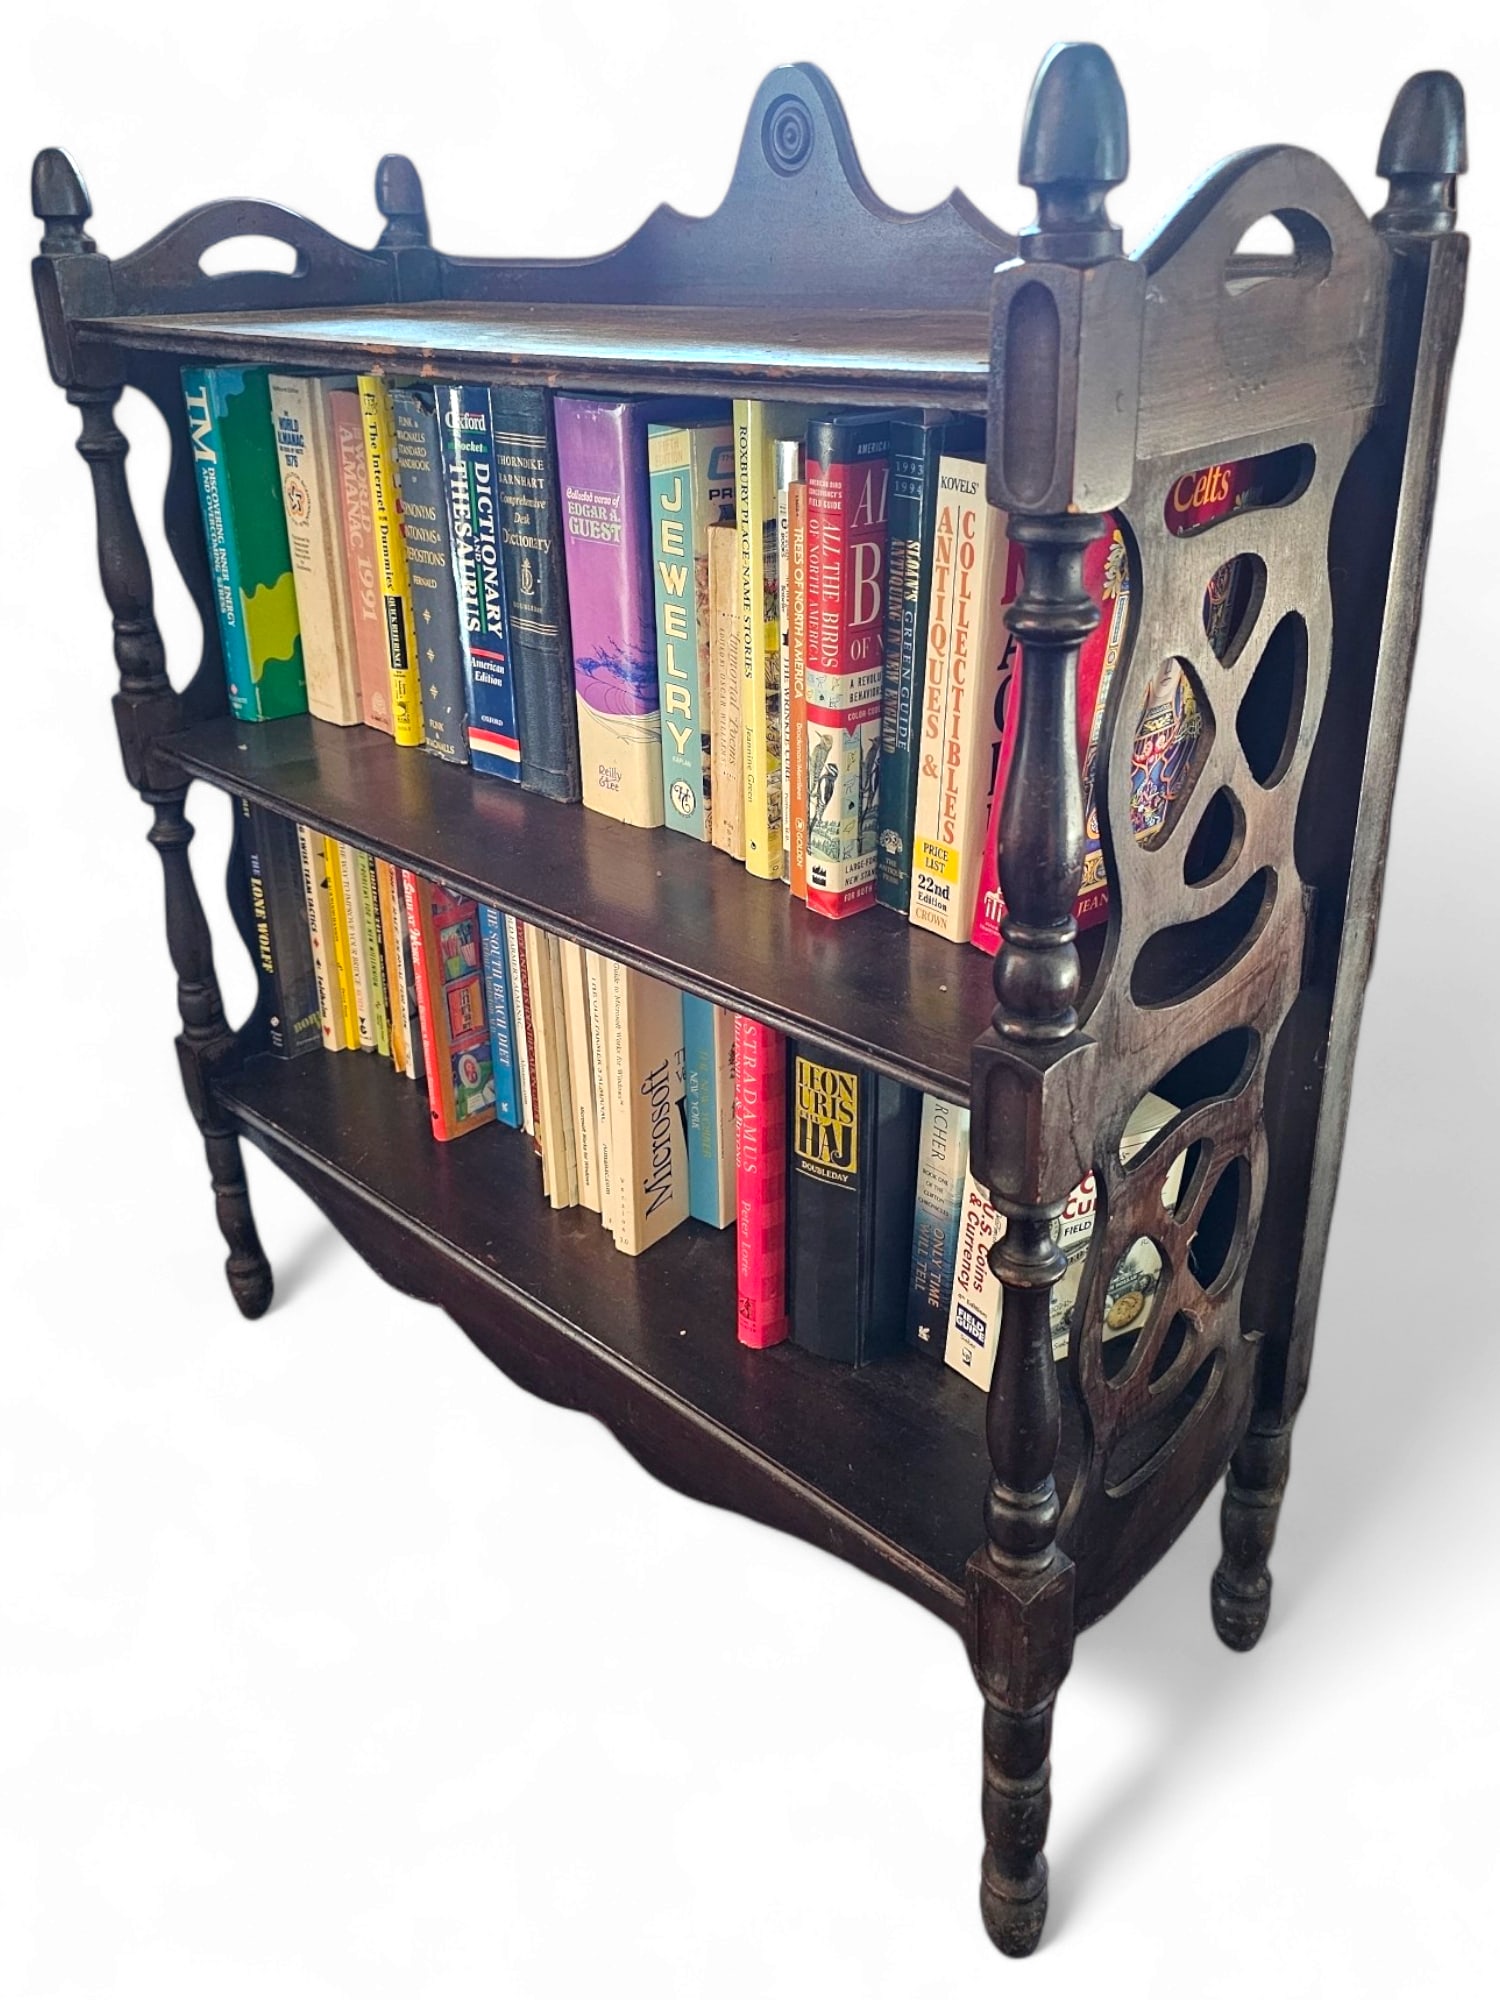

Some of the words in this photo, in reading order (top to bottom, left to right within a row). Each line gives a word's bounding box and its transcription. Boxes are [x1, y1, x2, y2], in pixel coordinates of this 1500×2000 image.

[185, 386, 217, 465] TM
[369, 422, 378, 449] The
[444, 411, 487, 432] Oxford
[496, 454, 545, 471] THORNDIKE
[739, 426, 749, 506] ROXBURY
[857, 442, 890, 456] AMERICA
[202, 467, 211, 492] AND
[372, 454, 386, 511] Internet
[498, 472, 545, 489] BARNHART
[895, 460, 924, 475] 1993
[354, 443, 371, 532] WORLD
[566, 486, 593, 503] Collected
[612, 495, 620, 508] of
[895, 480, 923, 495] 1994
[1173, 465, 1232, 513] Celts
[207, 467, 224, 543] DISCOVERING
[513, 512, 531, 524] Desk
[567, 501, 607, 521] EDGAR
[609, 511, 621, 523] A.
[823, 500, 842, 511] GUIDE
[206, 496, 220, 572] OVERCOMING
[341, 426, 364, 548] ALMANAC
[360, 555, 377, 621] 1991
[502, 527, 552, 554] Dictionary
[568, 516, 622, 543] GUEST
[809, 518, 819, 539] OF
[822, 519, 842, 556] ALL
[380, 525, 394, 589] Dummies
[449, 459, 482, 633] THESAURUS
[472, 535, 482, 562] AND
[474, 462, 503, 639] DICTIONARY
[740, 509, 752, 611] PLACE-NAME
[793, 527, 805, 565] TREES
[218, 547, 229, 581] INNER
[793, 568, 805, 590] OF
[808, 545, 820, 595] NORTH
[888, 536, 906, 623] ANTIQUING
[903, 539, 921, 602] SLOAN'S
[822, 562, 840, 604] THE
[223, 584, 236, 627] ENERGY
[659, 476, 695, 755] JEWELRY
[793, 592, 804, 633] NORTH
[926, 505, 954, 739] ANTIQUES
[743, 615, 752, 678] STORIES
[808, 602, 819, 662] AMERICA
[820, 612, 840, 669] BIRDS
[850, 635, 871, 662] OF
[887, 628, 902, 646] IN
[901, 611, 914, 679] GREEN
[470, 657, 505, 675] American
[475, 670, 503, 687] Edition
[729, 630, 741, 711] Immortal
[793, 636, 804, 699] AMERICA
[858, 671, 882, 687] REVOLU
[885, 650, 901, 684] NEW
[943, 510, 976, 845] COLLECTIBLES
[848, 709, 867, 721] COLOR
[882, 688, 900, 755] ENGLAND
[897, 685, 911, 750] GUIDE
[729, 717, 740, 764] Poems
[745, 727, 754, 770] Jeannine
[598, 764, 622, 781] Reilly
[922, 754, 938, 779] &
[747, 773, 755, 803] Green
[251, 854, 261, 877] THE
[300, 837, 308, 864] SWISS
[923, 841, 949, 862] PRICE
[925, 856, 946, 874] LIST
[251, 877, 267, 919] LONE
[303, 868, 312, 894] TEAM
[844, 875, 859, 887] NEW
[844, 890, 856, 903] FOR
[857, 886, 873, 900] BOTH
[917, 874, 951, 901] 22nd
[307, 897, 317, 933] TACTICS
[344, 893, 354, 928] IMPROVE
[363, 902, 371, 916] FOR
[915, 907, 948, 930] CROWN
[917, 892, 948, 912] Edition
[1076, 892, 1109, 917] JEAN
[257, 922, 274, 974] WOLFF
[486, 930, 505, 979] SOUTH
[508, 935, 519, 981] FARMER'S
[612, 963, 620, 983] Guide
[490, 982, 509, 1027] BEACH
[512, 984, 523, 1027] ALMANAC
[614, 995, 622, 1029] Microsoft
[495, 1031, 512, 1067] DIET
[688, 1070, 699, 1097] NEW
[738, 1023, 761, 1174] STRADAMUS
[799, 1061, 855, 1102] LEON
[688, 1101, 701, 1129] YORK
[799, 1086, 854, 1124] URIS
[641, 1057, 673, 1221] Microsoft
[799, 1117, 853, 1168] HAJ
[931, 1103, 949, 1161] RCHER
[801, 1160, 849, 1183] DOUBLEDAY
[922, 1167, 938, 1179] BOOK
[923, 1189, 945, 1205] CLIFTON
[968, 1192, 982, 1207] &
[739, 1200, 752, 1236] Peter
[978, 1202, 995, 1236] U.S.
[1064, 1220, 1092, 1238] FIELD
[917, 1223, 930, 1255] WILL
[930, 1228, 944, 1268] ONLY
[956, 1210, 980, 1292] Currency
[739, 1241, 753, 1276] Lorie
[972, 1243, 990, 1293] Coins
[914, 1261, 927, 1291] TELL
[927, 1272, 941, 1307] TIME
[957, 1307, 986, 1332] FIELD
[966, 1297, 988, 1319] Edition
[955, 1316, 985, 1343] GUIDE
